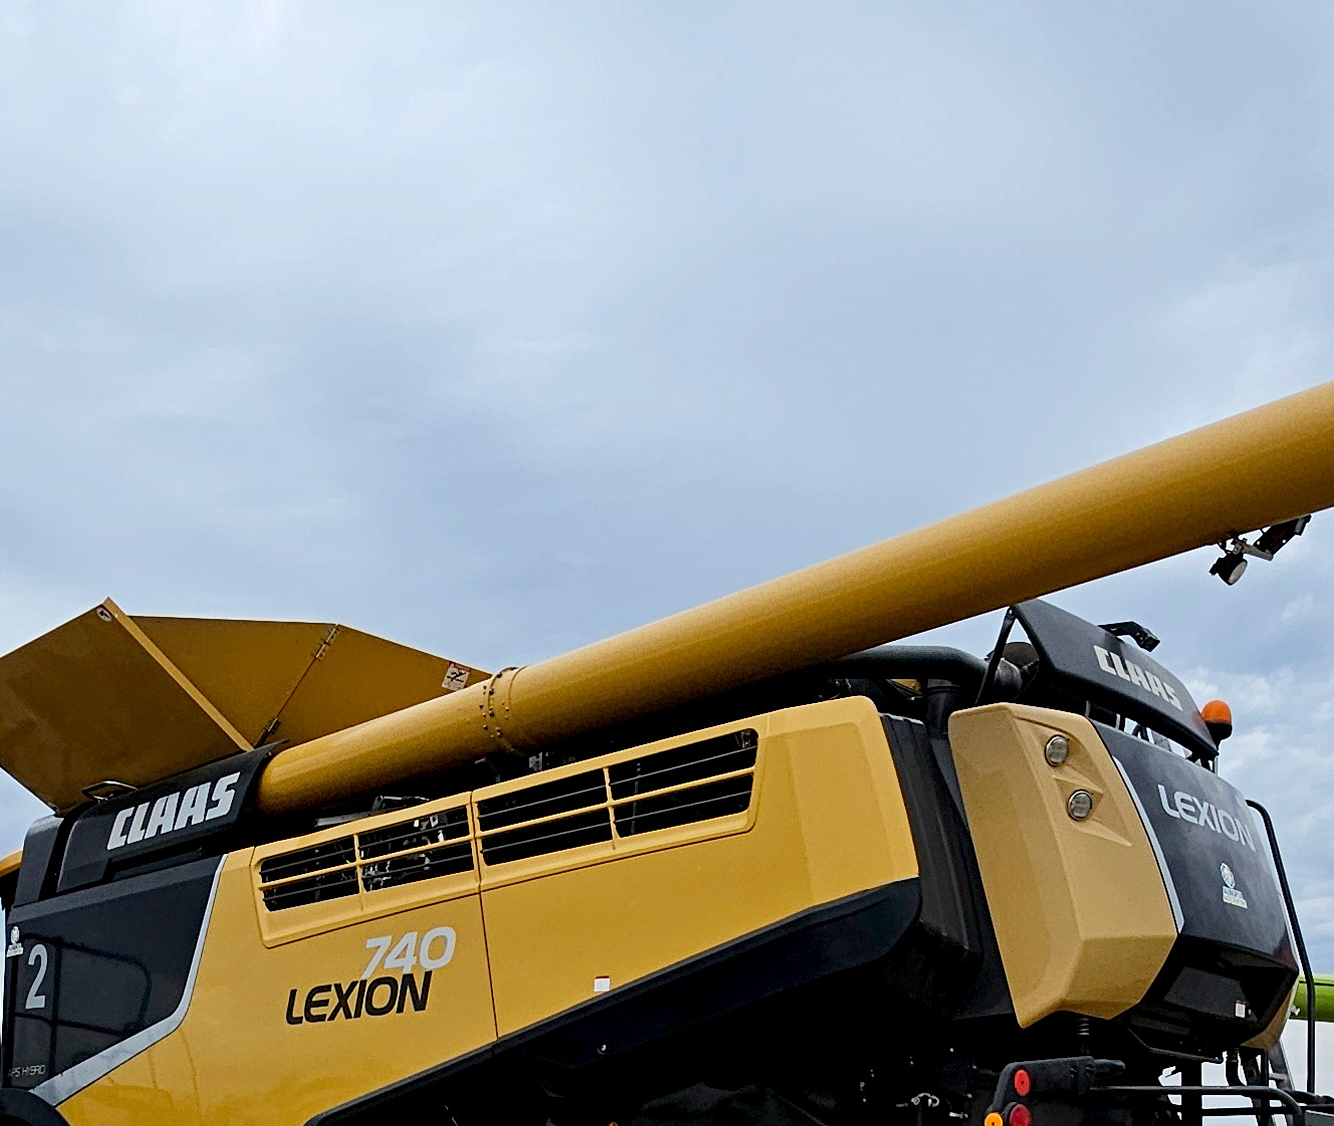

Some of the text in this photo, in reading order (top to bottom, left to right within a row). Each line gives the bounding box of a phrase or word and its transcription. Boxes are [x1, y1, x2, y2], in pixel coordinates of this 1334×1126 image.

[1093, 645, 1183, 711] CLAAS
[107, 771, 241, 850] CLAAS
[1157, 784, 1257, 852] LEXION
[25, 943, 48, 1010] 2
[361, 926, 457, 980] 740
[286, 970, 433, 1025] LEXION
